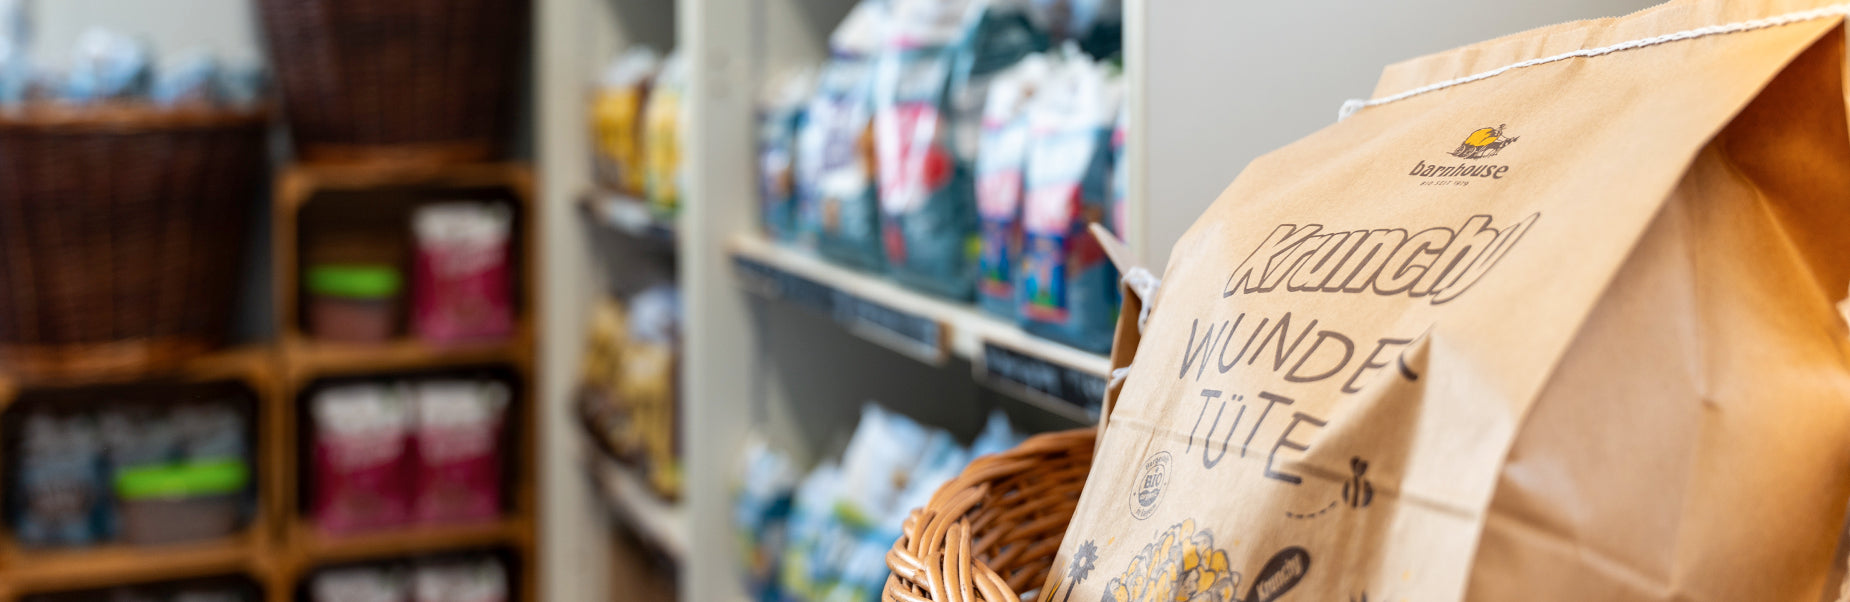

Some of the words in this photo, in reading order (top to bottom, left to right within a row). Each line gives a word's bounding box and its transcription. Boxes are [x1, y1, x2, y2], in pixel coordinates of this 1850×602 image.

[1408, 160, 1510, 180] barnhouse
[1223, 212, 1541, 305] Krunchy
[1185, 389, 1329, 485] TÜTE
[1144, 473, 1163, 489] BIO
[1256, 553, 1302, 602] Krunchy
